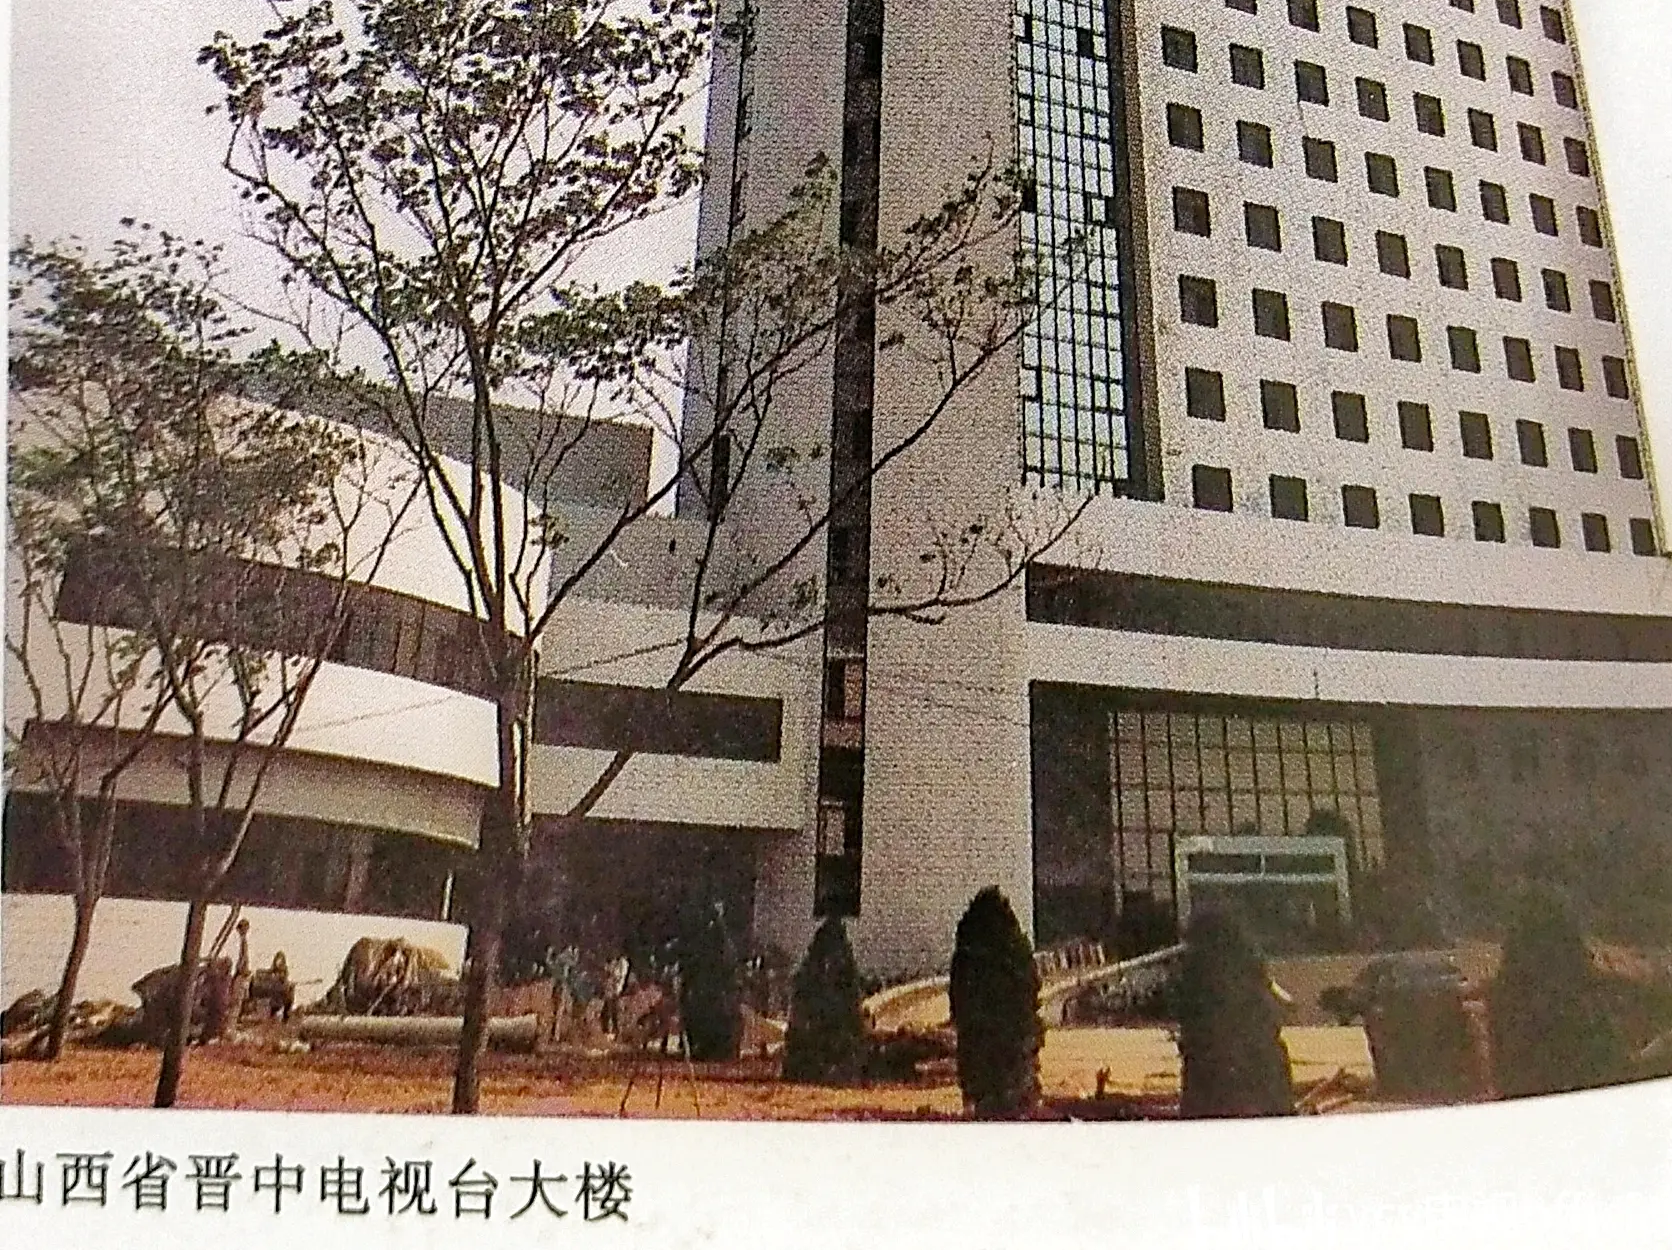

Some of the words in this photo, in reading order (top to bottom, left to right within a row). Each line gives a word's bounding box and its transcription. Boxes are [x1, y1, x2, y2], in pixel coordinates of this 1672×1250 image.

[0, 1149, 633, 1222] 山西省晋中电视台大楼
